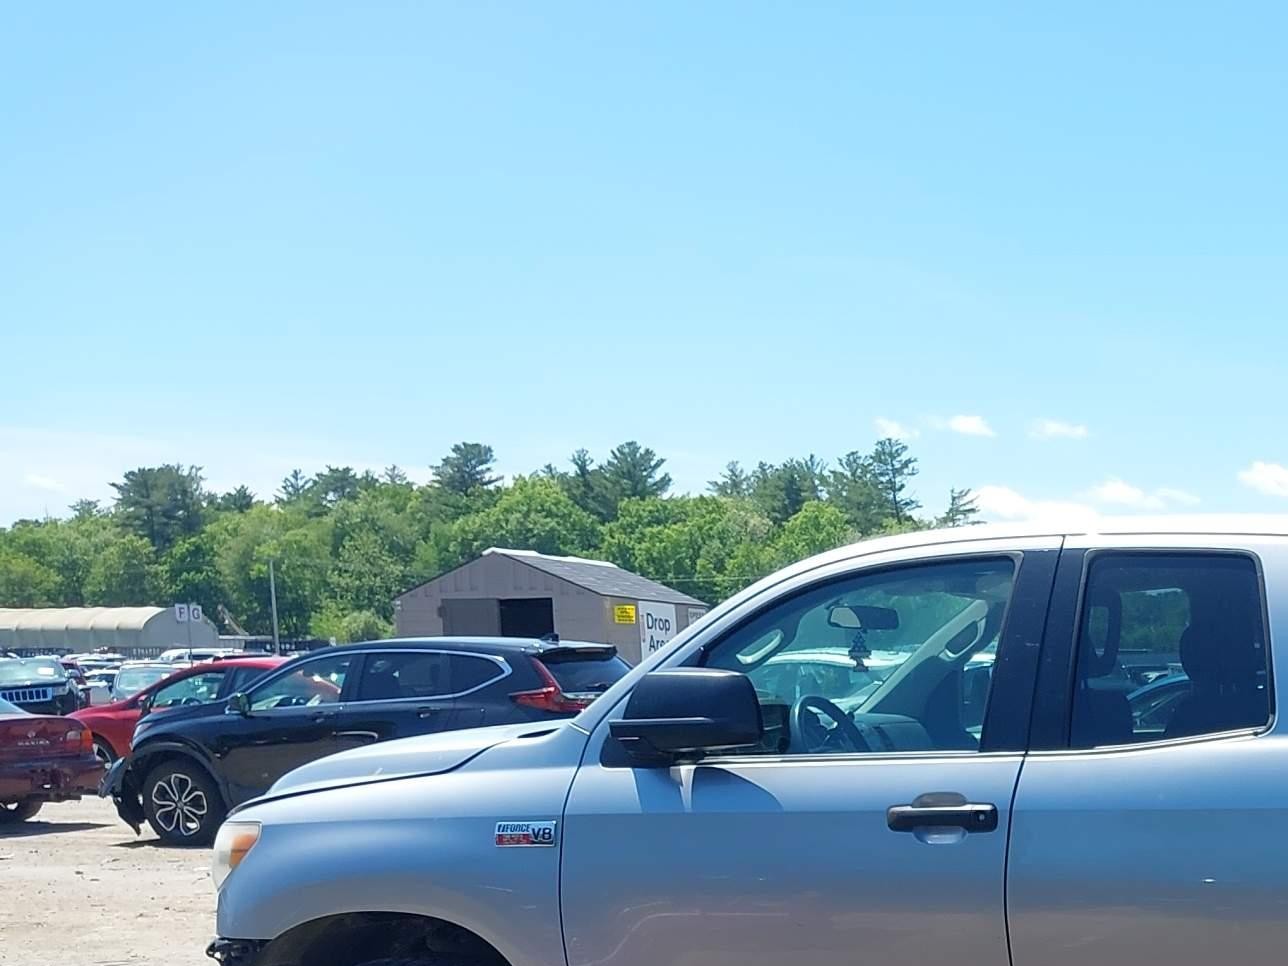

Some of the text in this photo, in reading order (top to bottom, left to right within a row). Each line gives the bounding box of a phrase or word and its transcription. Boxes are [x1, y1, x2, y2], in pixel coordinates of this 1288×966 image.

[178, 607, 186, 619] F
[646, 612, 671, 635] Drop
[532, 826, 553, 841] V8
